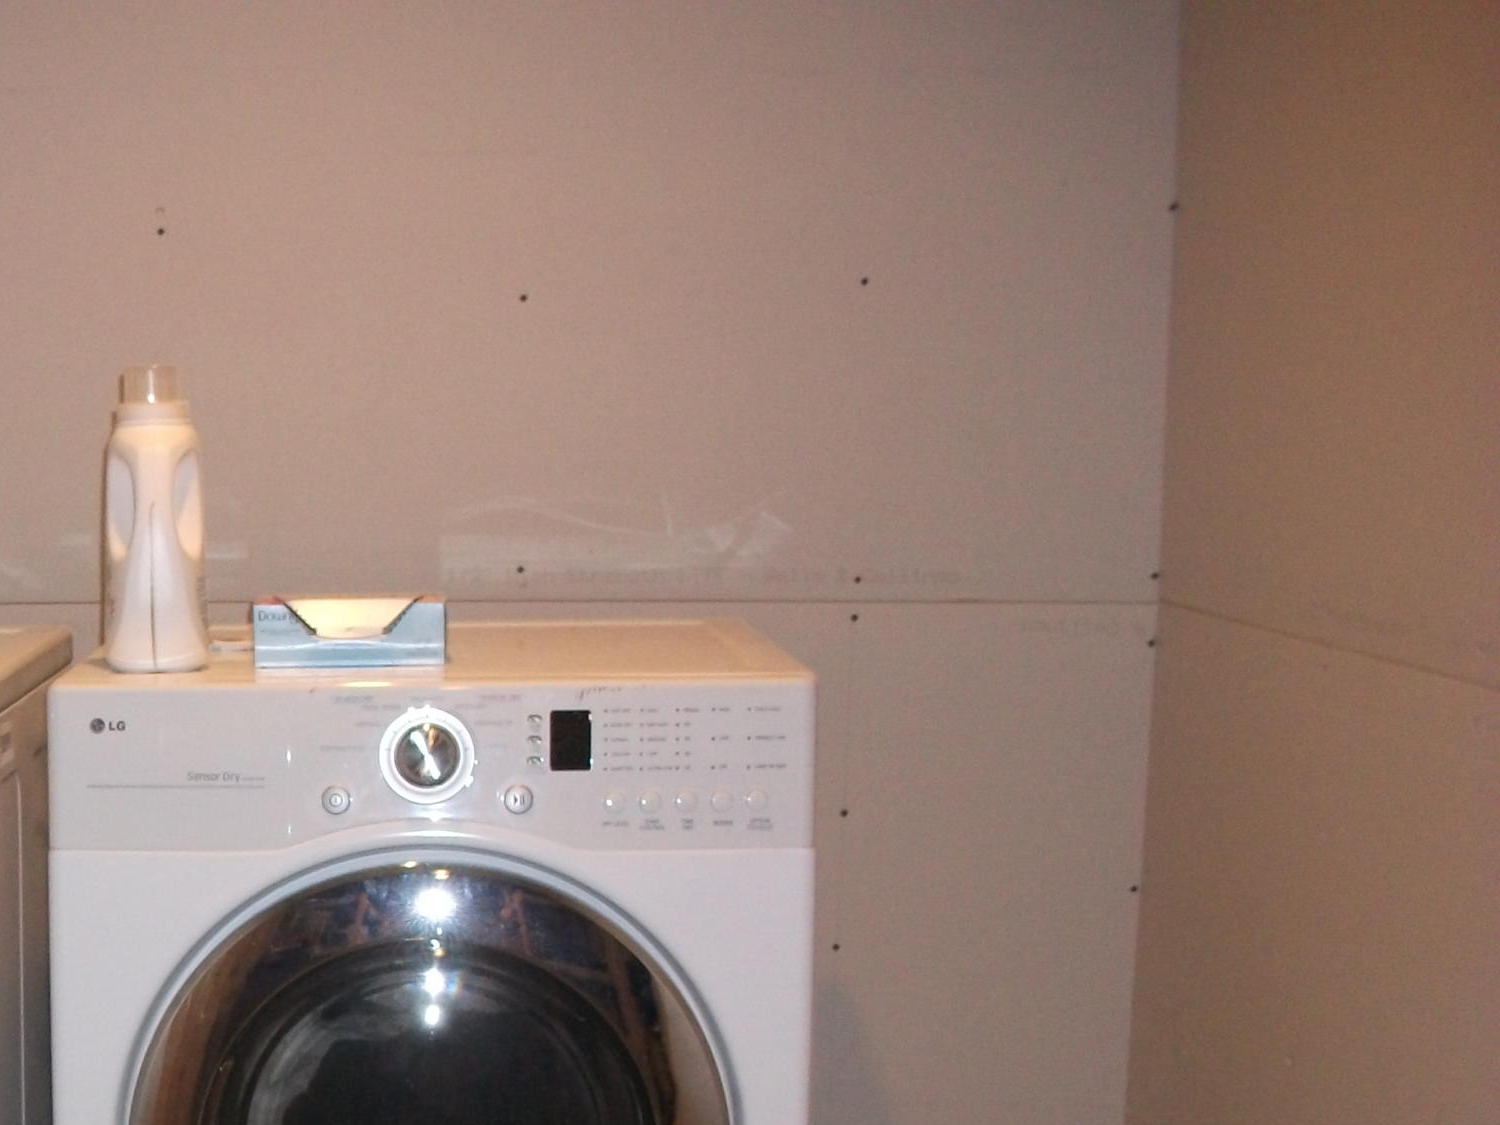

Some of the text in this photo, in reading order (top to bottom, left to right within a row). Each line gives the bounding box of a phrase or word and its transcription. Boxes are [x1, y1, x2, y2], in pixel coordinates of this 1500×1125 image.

[108, 720, 126, 731] LG
[187, 771, 241, 784] Sensor Dry
